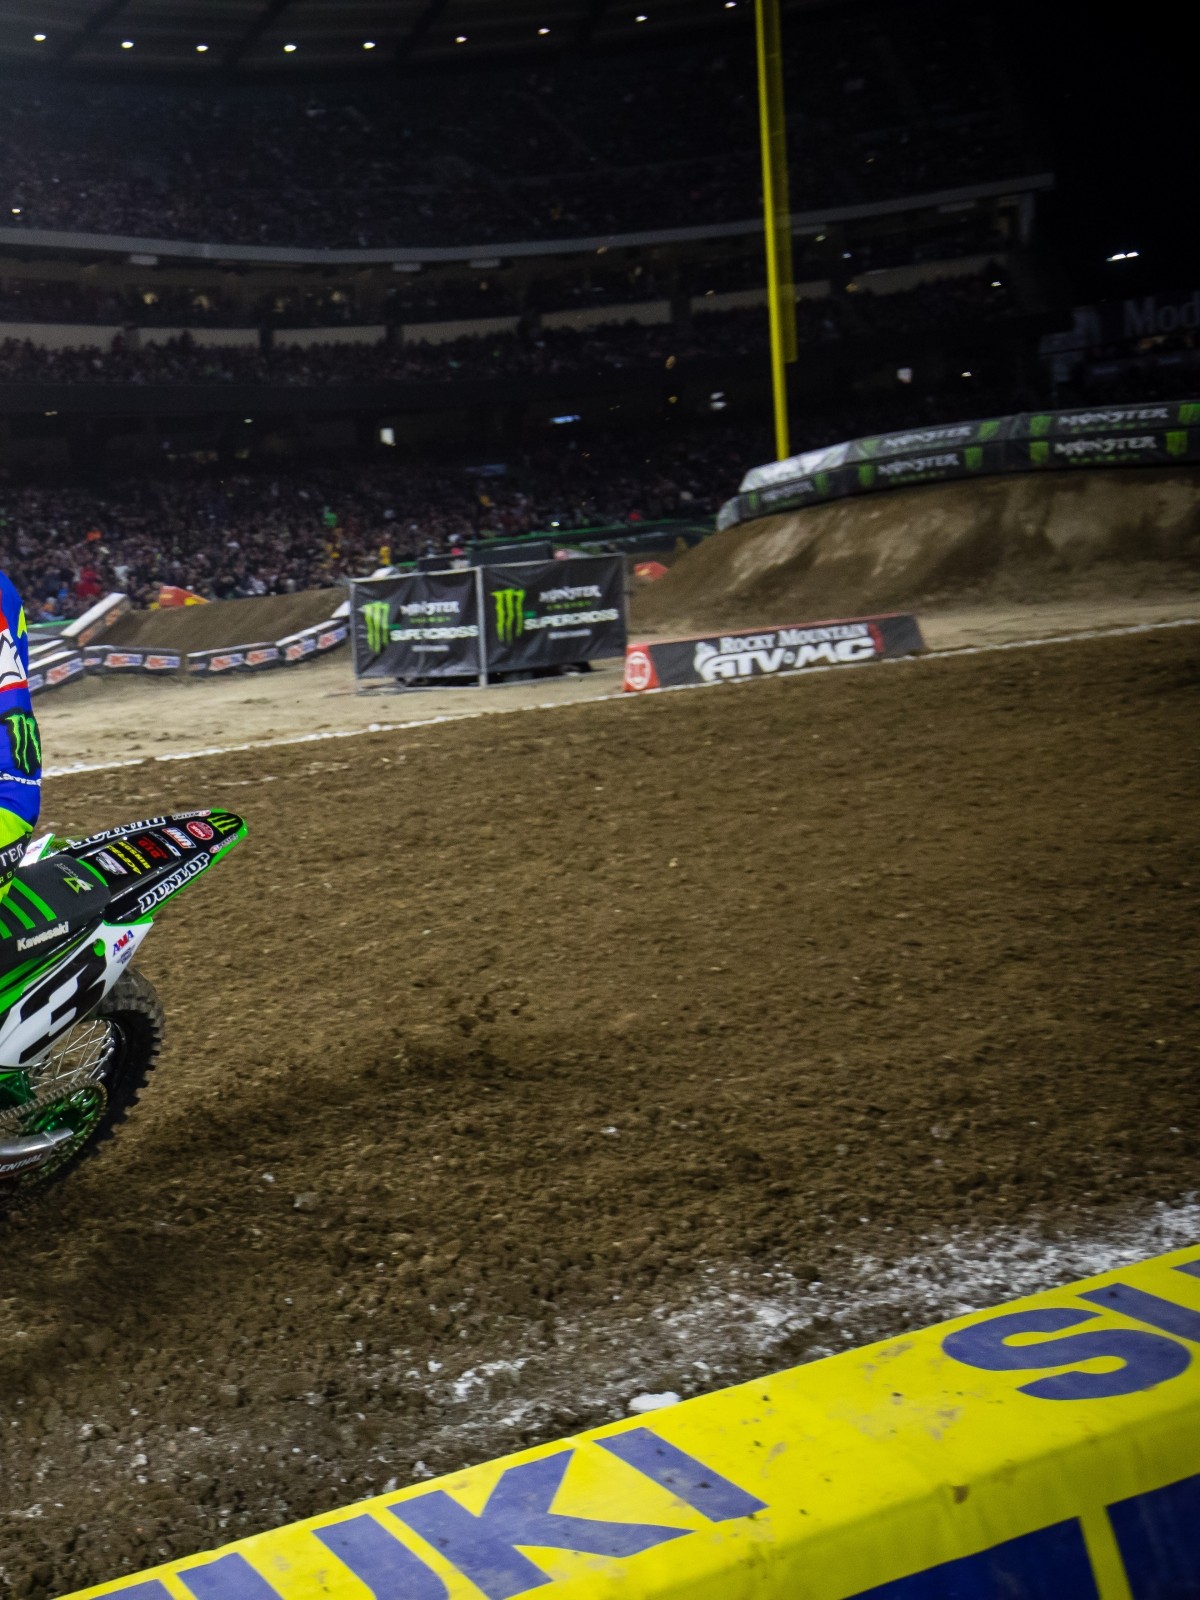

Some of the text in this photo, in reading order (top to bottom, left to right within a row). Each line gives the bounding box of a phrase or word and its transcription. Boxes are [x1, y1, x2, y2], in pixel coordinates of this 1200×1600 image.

[1123, 289, 1200, 337] Mod
[390, 625, 478, 641] SUPERCROSS
[523, 608, 619, 630] SUPERCROSS
[720, 623, 868, 655] ROCKY MOUNTAIN
[138, 852, 210, 913] DUNLOP
[16, 921, 69, 952] Kawasaki
[112, 929, 135, 957] AMA
[18, 945, 107, 1064] 3
